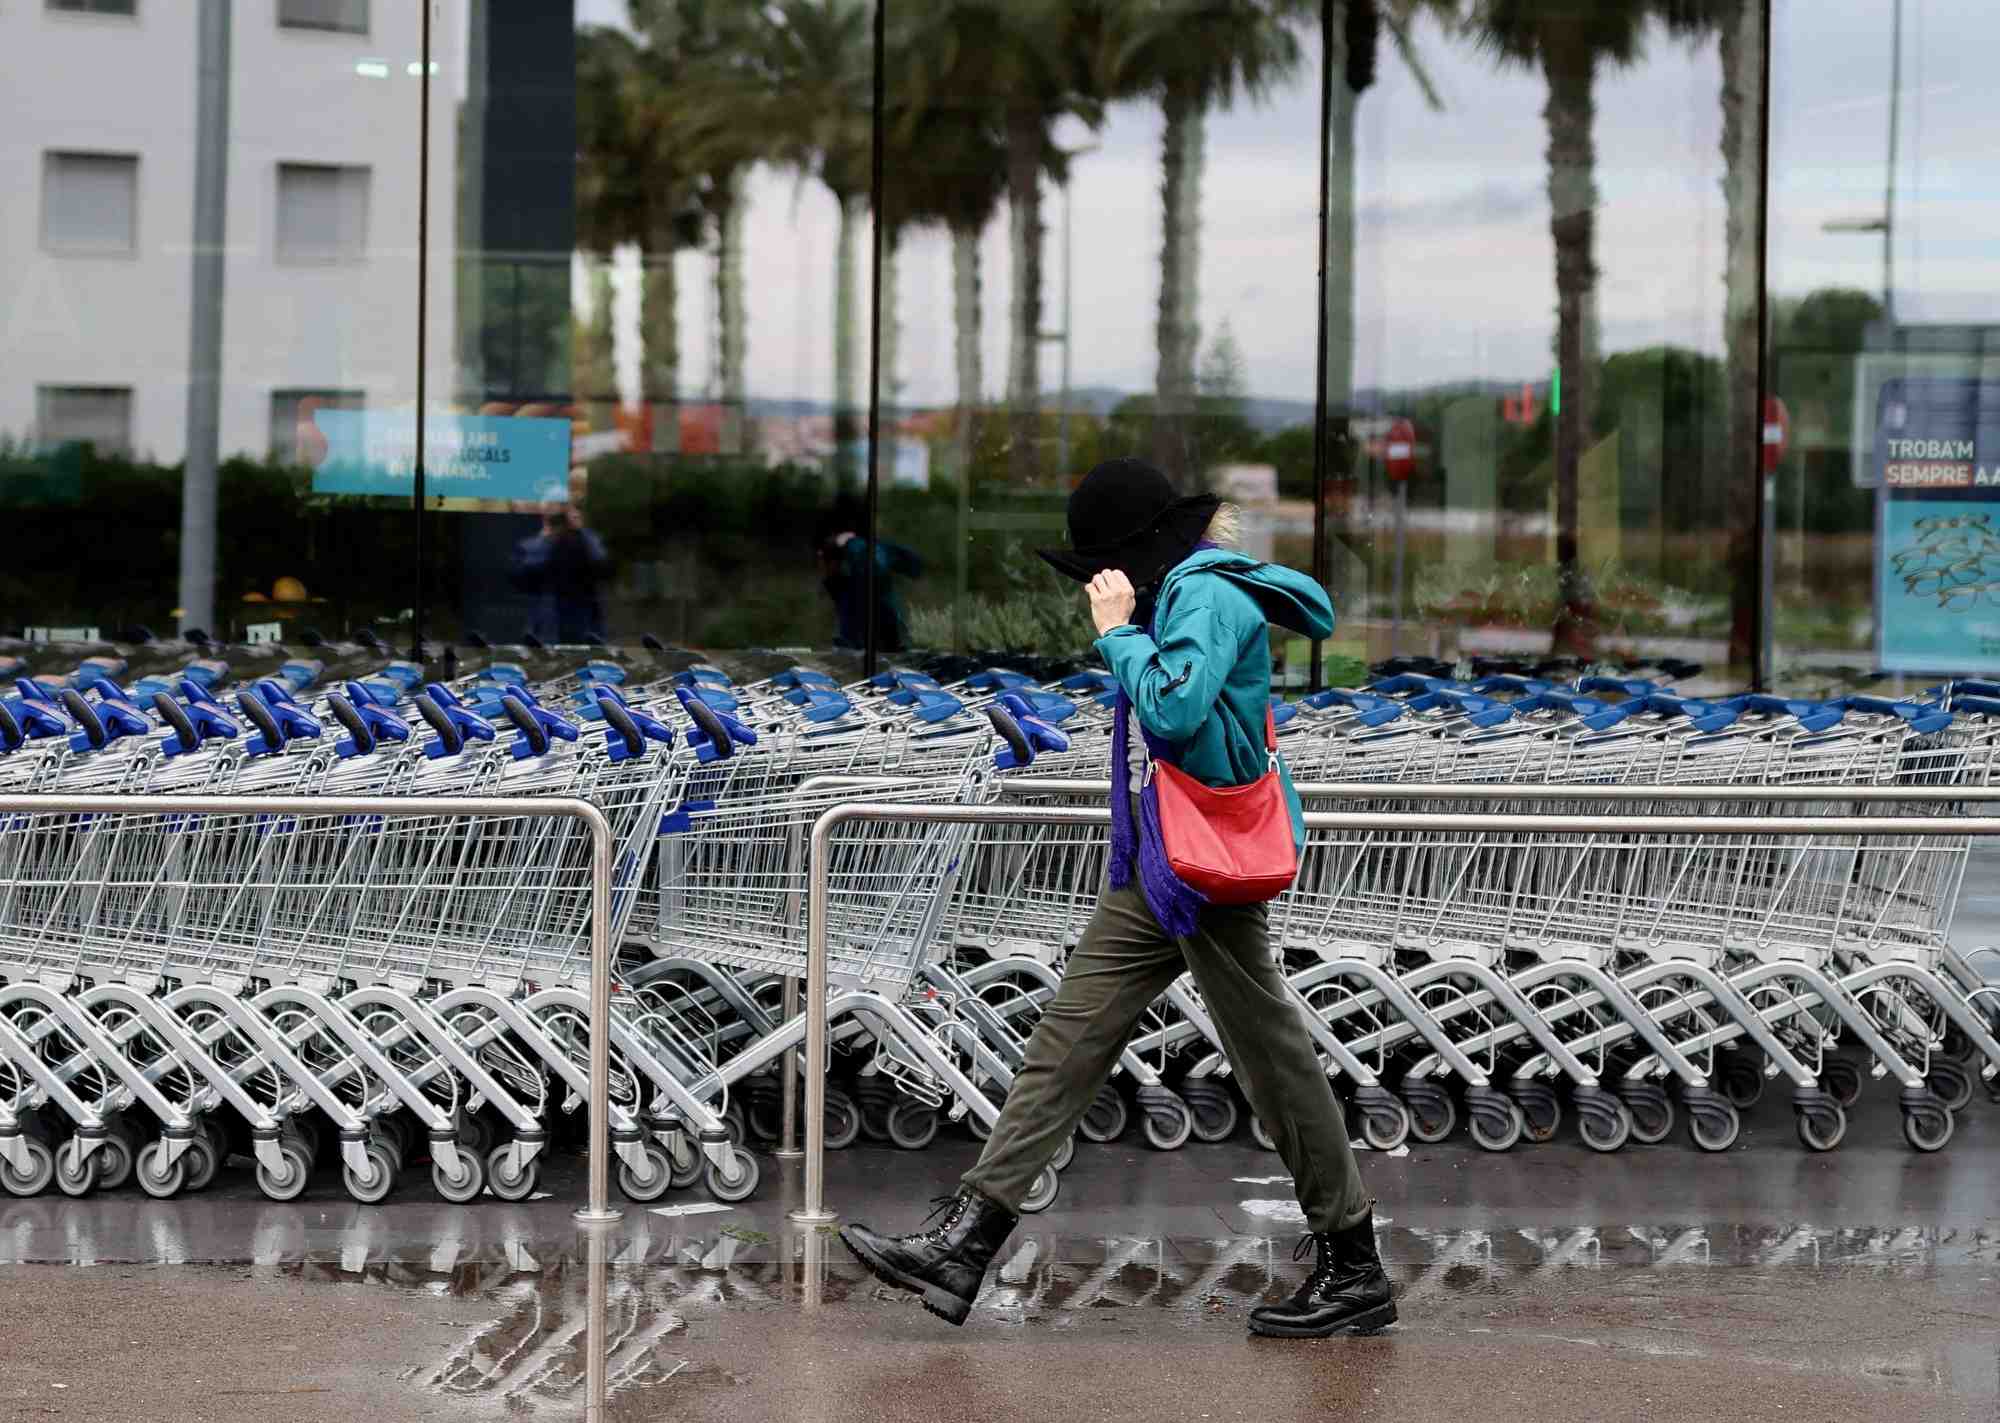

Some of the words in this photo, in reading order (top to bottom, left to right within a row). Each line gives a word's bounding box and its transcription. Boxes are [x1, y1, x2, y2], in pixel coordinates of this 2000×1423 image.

[459, 447, 511, 464] LOCALS
[1887, 465, 1968, 484] SEMPRE
[1975, 466, 1989, 485] A
